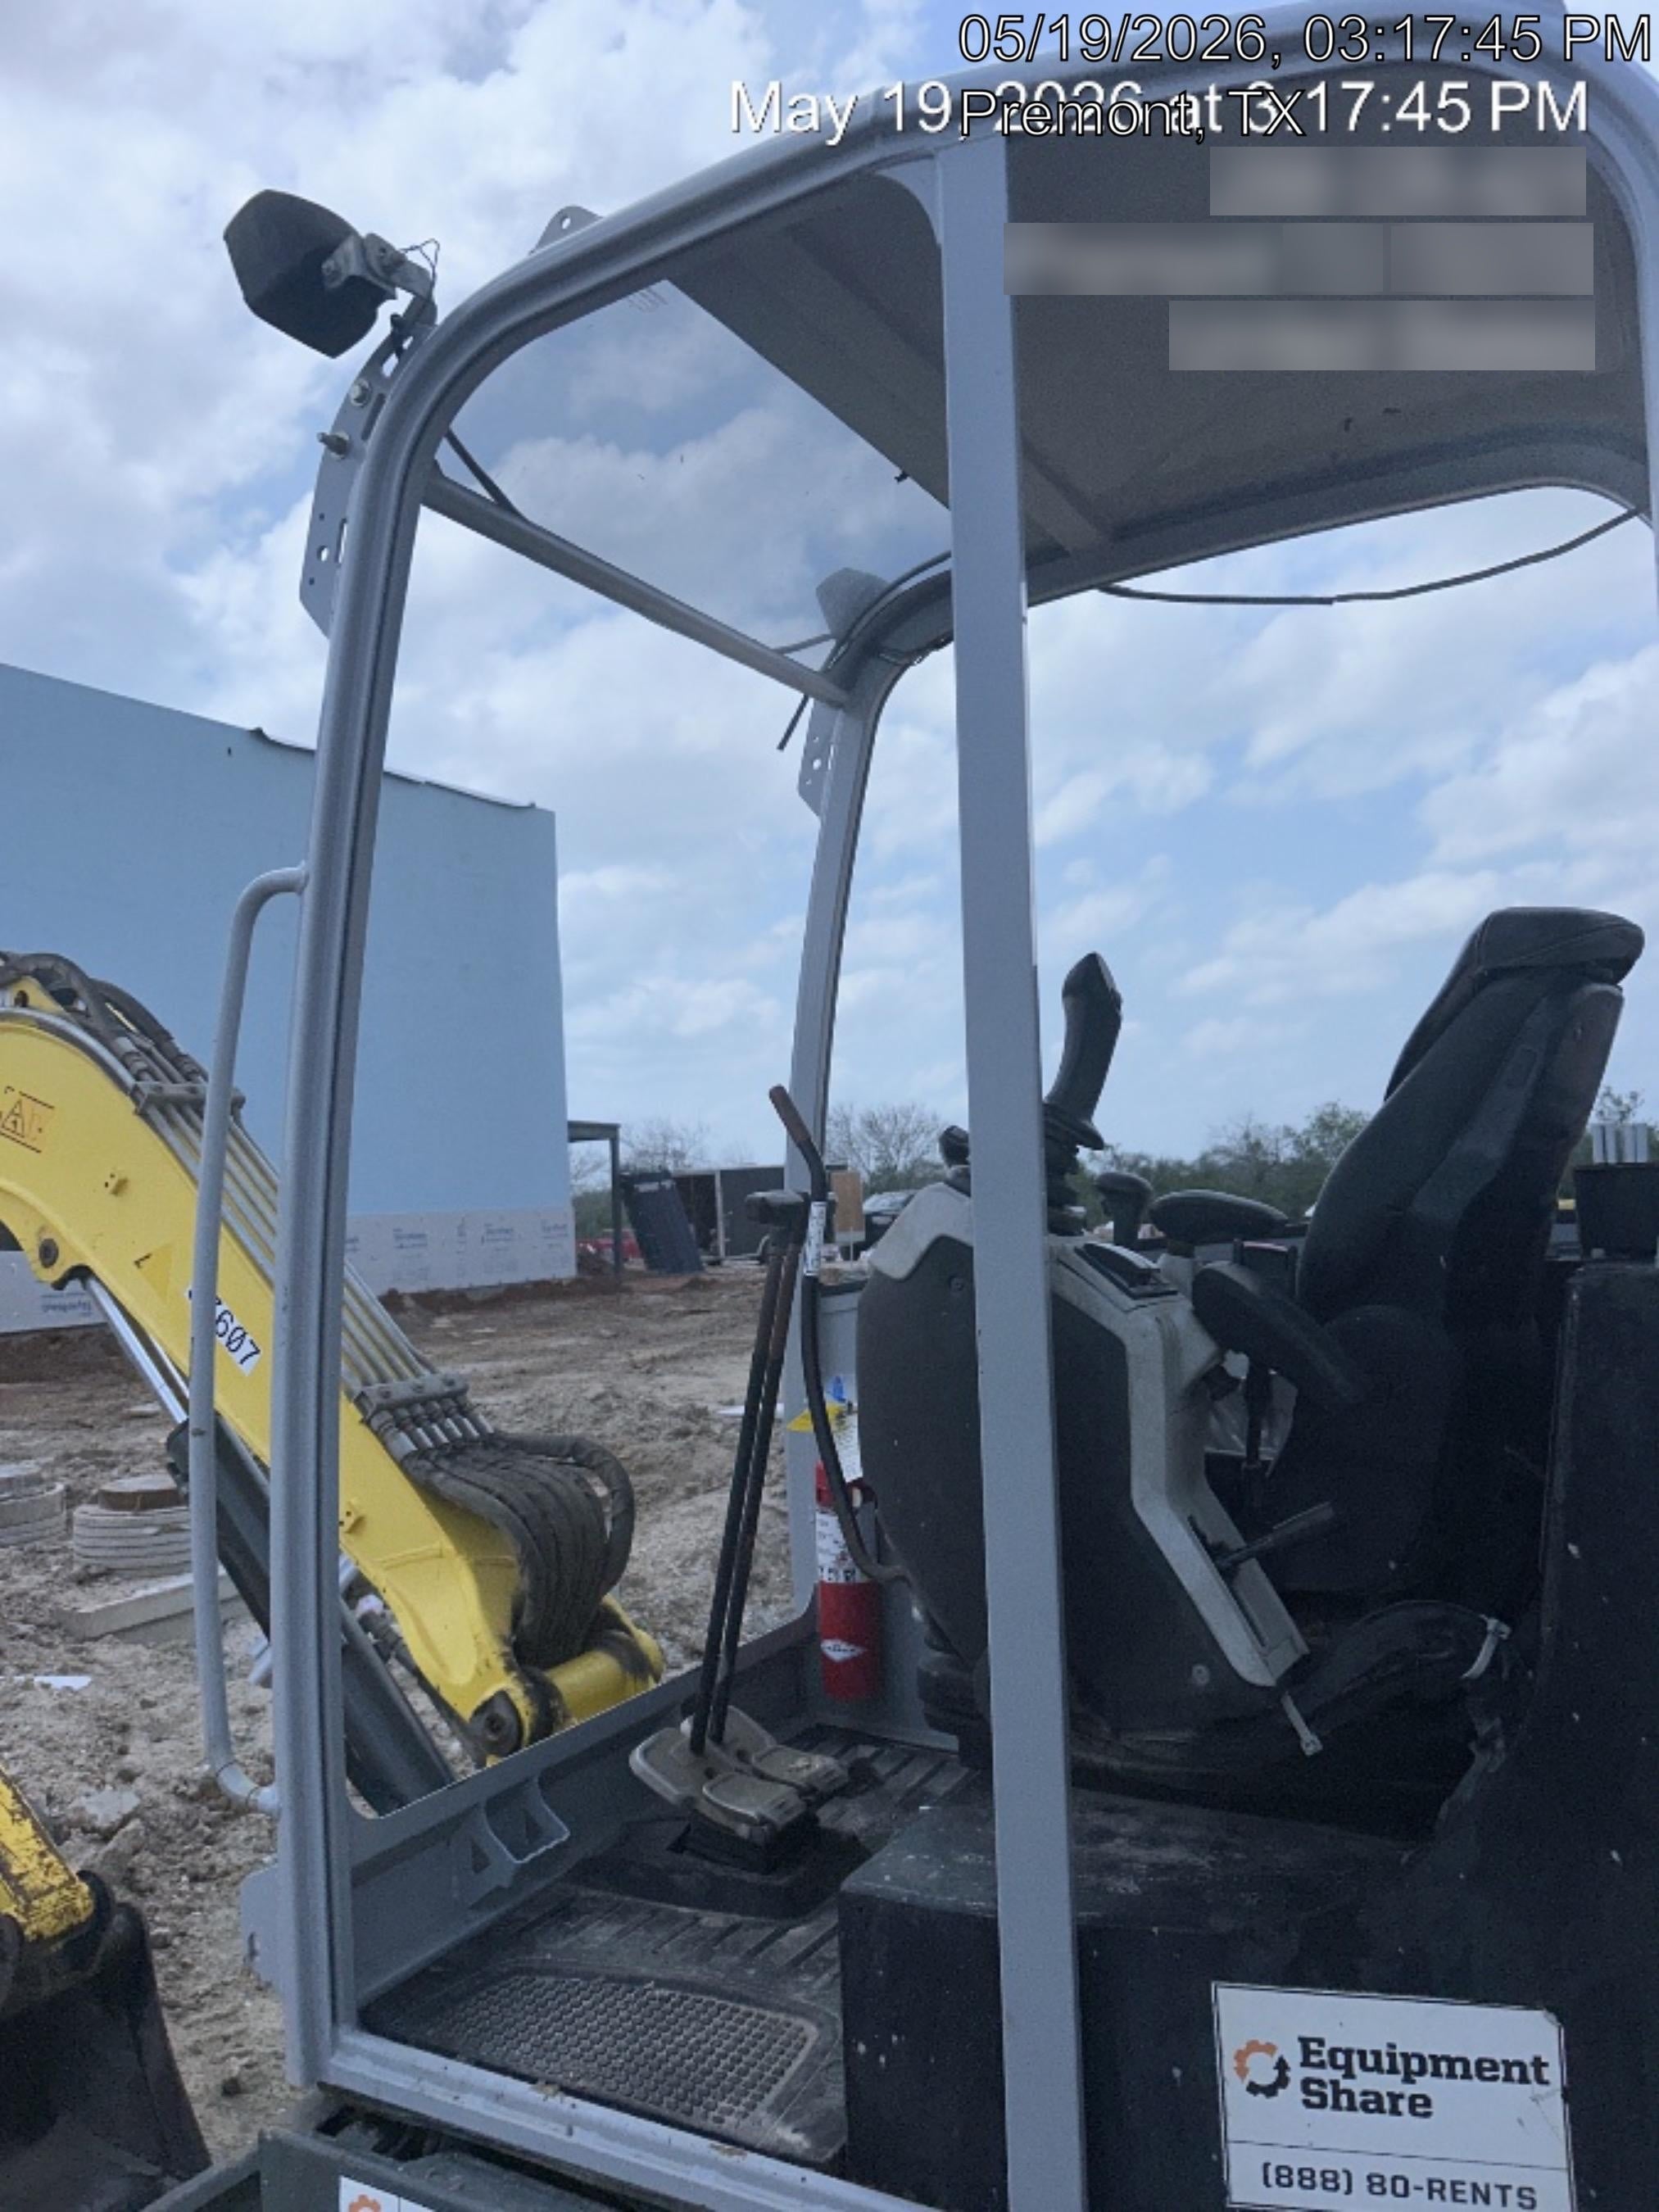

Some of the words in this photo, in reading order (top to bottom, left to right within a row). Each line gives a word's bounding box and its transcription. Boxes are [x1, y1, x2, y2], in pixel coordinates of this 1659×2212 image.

[1298, 2036, 1550, 2085] Equipment
[1300, 2078, 1433, 2119] Share
[1262, 2161, 1353, 2196] (888)
[1366, 2172, 1538, 2210] 80-RENTS
